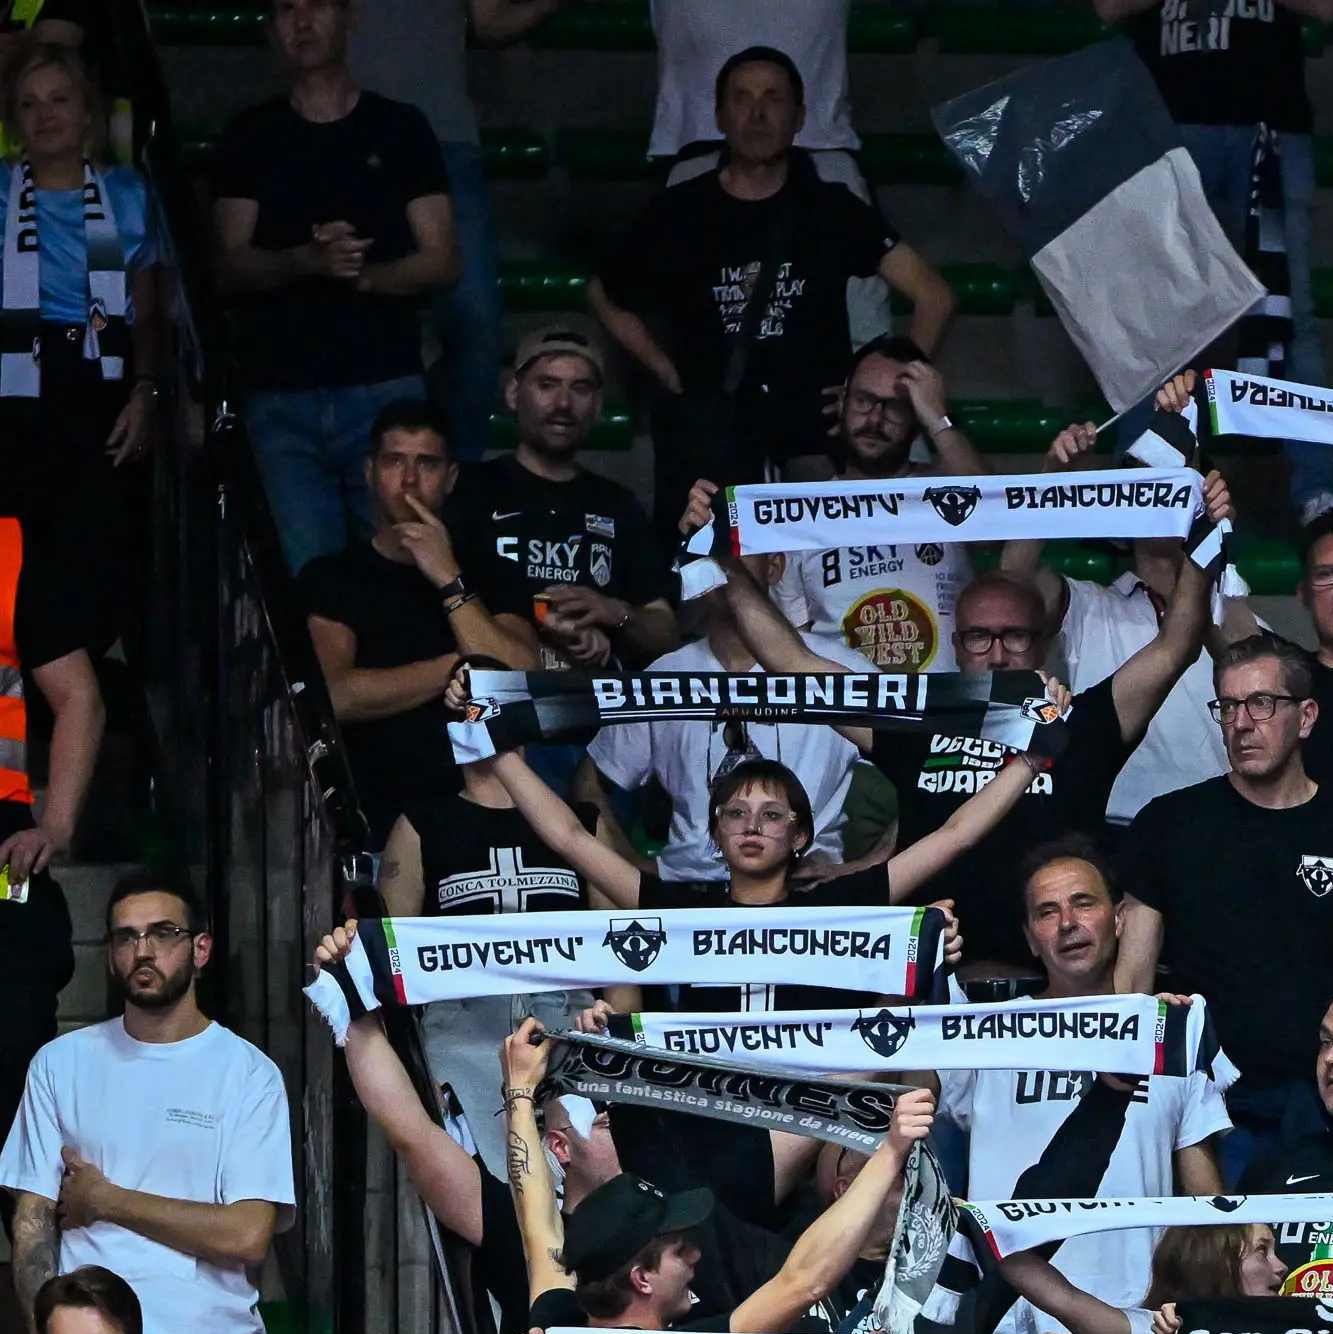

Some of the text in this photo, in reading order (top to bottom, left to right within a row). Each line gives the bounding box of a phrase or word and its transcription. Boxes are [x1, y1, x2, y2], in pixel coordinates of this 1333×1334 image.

[753, 493, 906, 525] GIOVENTU'
[1005, 481, 1190, 511] BIANCONERA
[526, 537, 581, 568] SKY
[822, 548, 842, 589] 8
[526, 564, 580, 583] ENERGY
[849, 559, 905, 580] ENERGY
[859, 599, 911, 624] OLD
[593, 674, 928, 708] BIANCONERI
[753, 708, 799, 717] UDINE
[438, 874, 579, 899] CONCA TOLMEZZINA
[390, 928, 918, 974] 2024 GIOVENTU' BIANCONERA 2024
[664, 1022, 833, 1055] GIOVENTU'
[941, 1011, 1139, 1042] BIANCONERA
[1155, 1016, 1165, 1043] 2024
[579, 1045, 898, 1134] UDINES
[577, 1079, 875, 1147] una fantastica stagione da vivere
[972, 1207, 991, 1232] 2024
